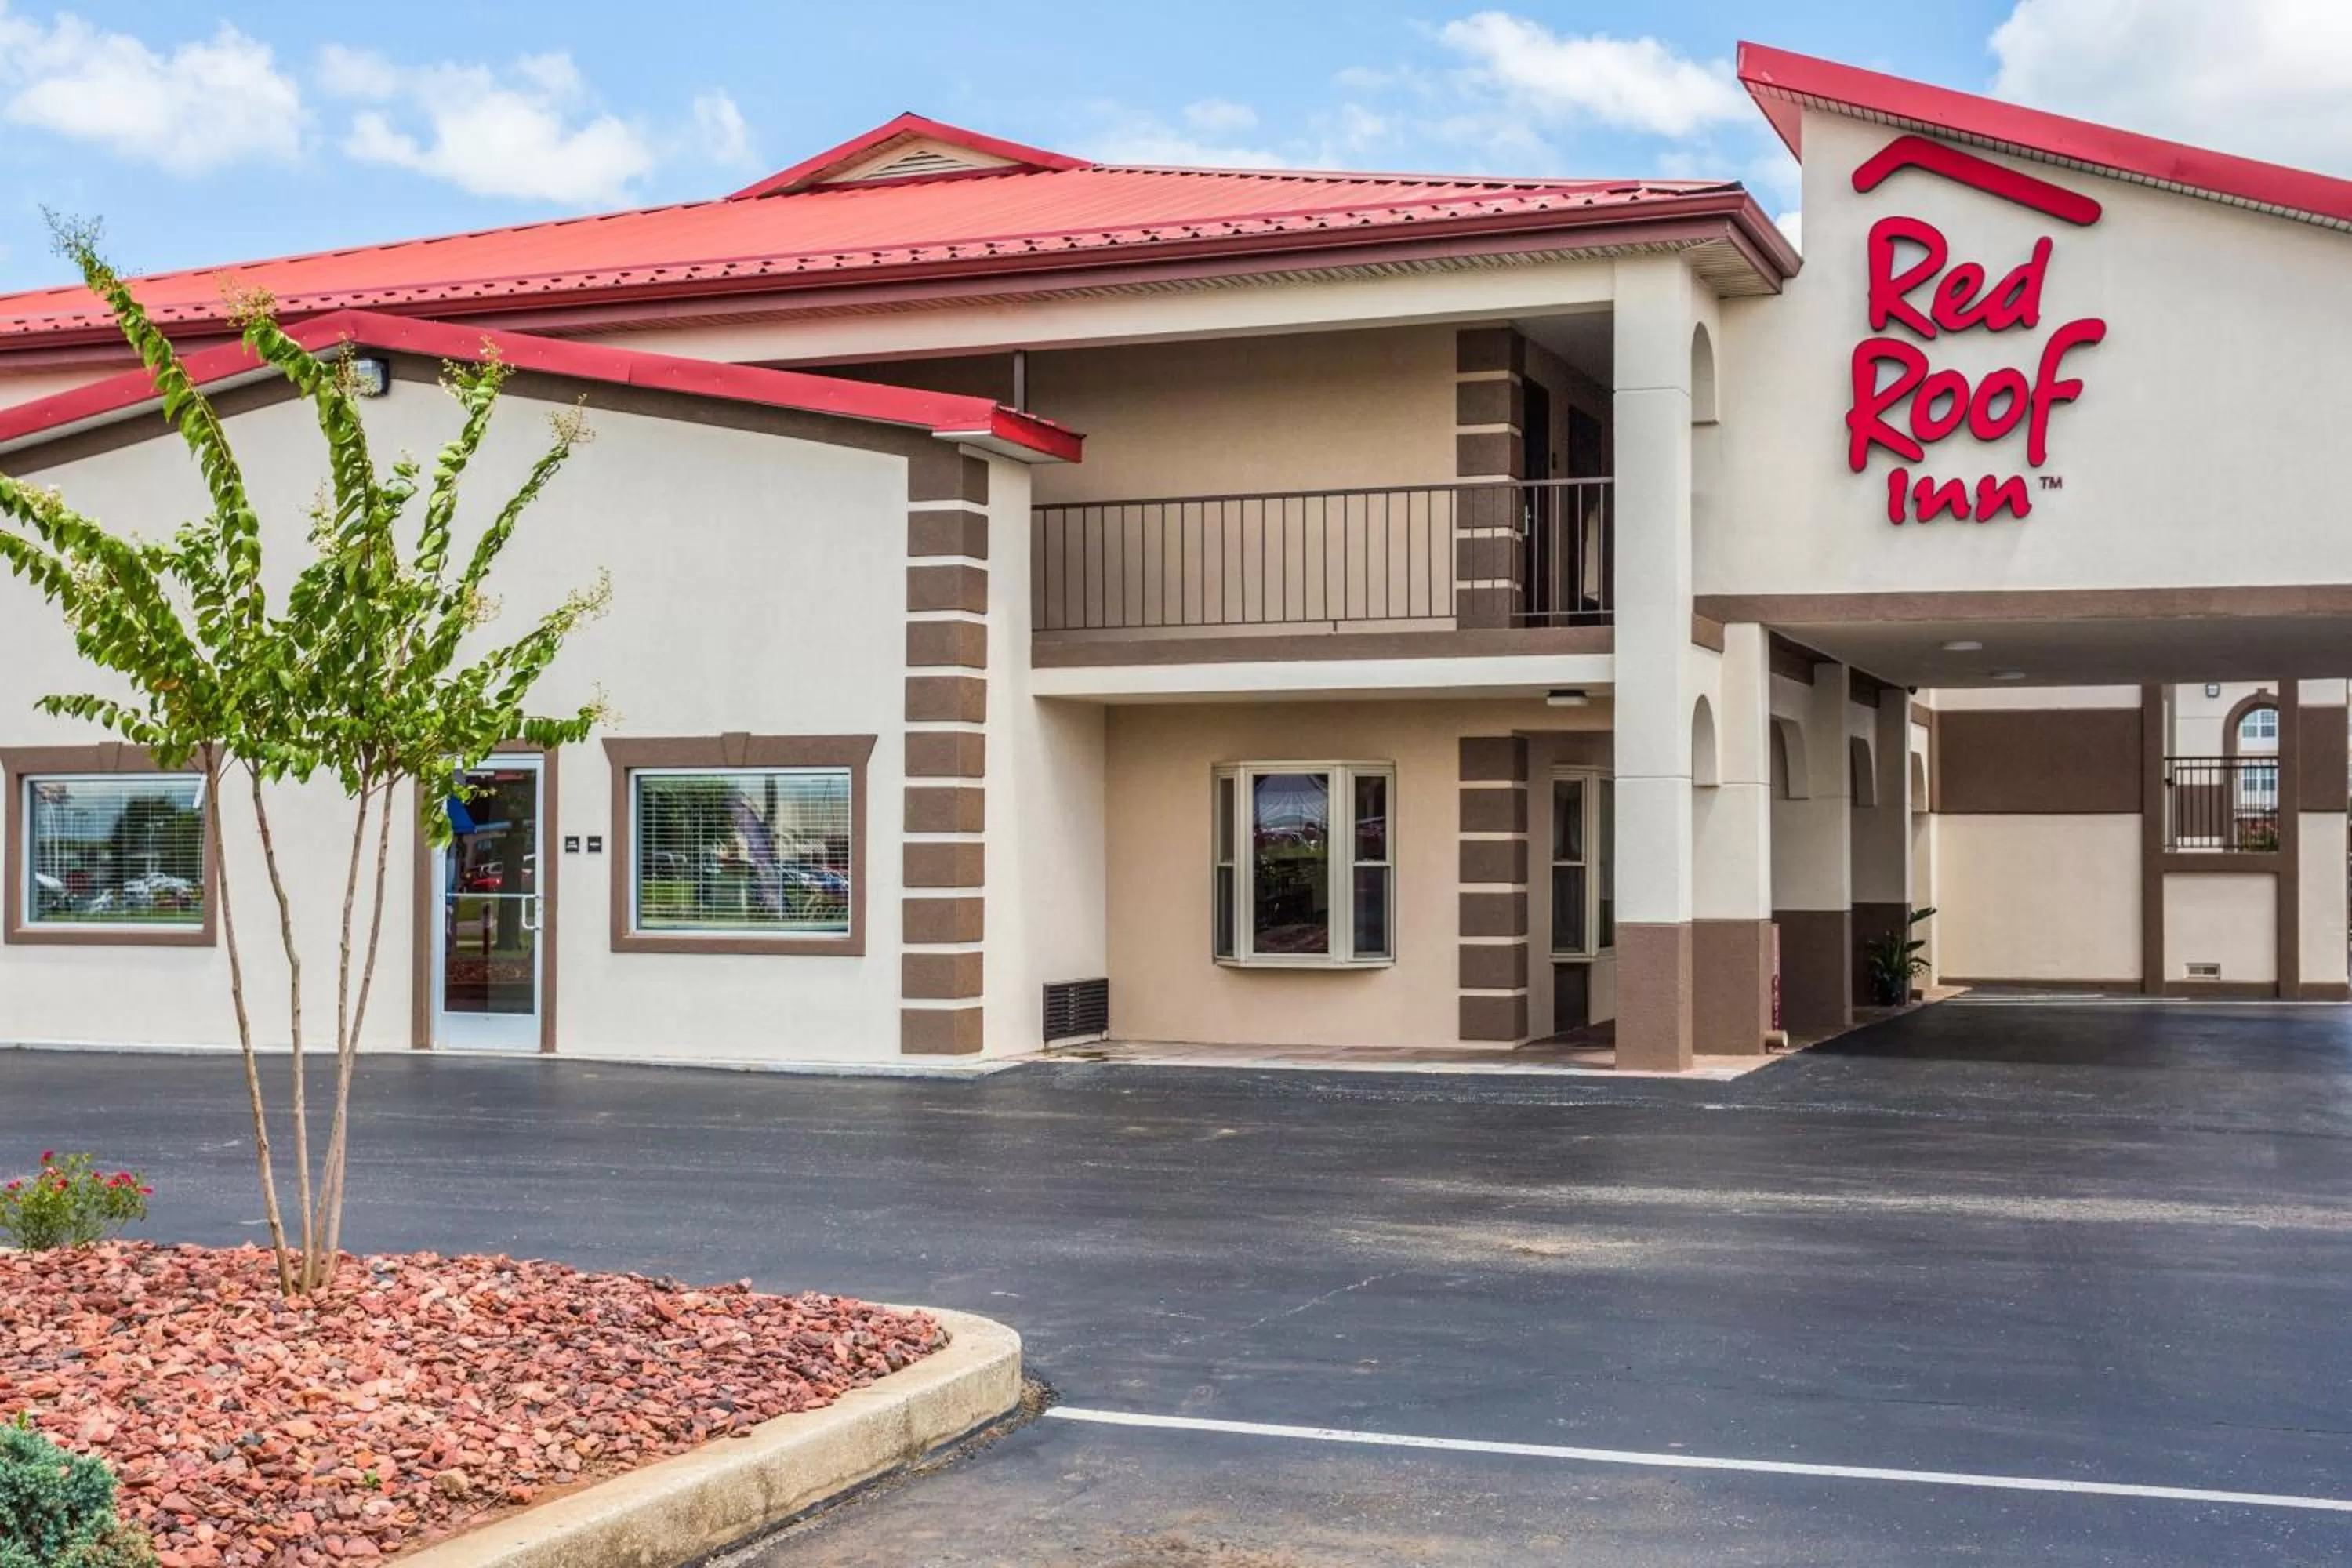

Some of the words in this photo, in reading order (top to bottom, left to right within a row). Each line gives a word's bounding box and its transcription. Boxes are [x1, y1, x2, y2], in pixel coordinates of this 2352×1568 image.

[1867, 216, 2053, 340] Red
[1846, 318, 2107, 473] Roof
[1887, 467, 2032, 525] Inn
[2039, 476, 2063, 490] TM
